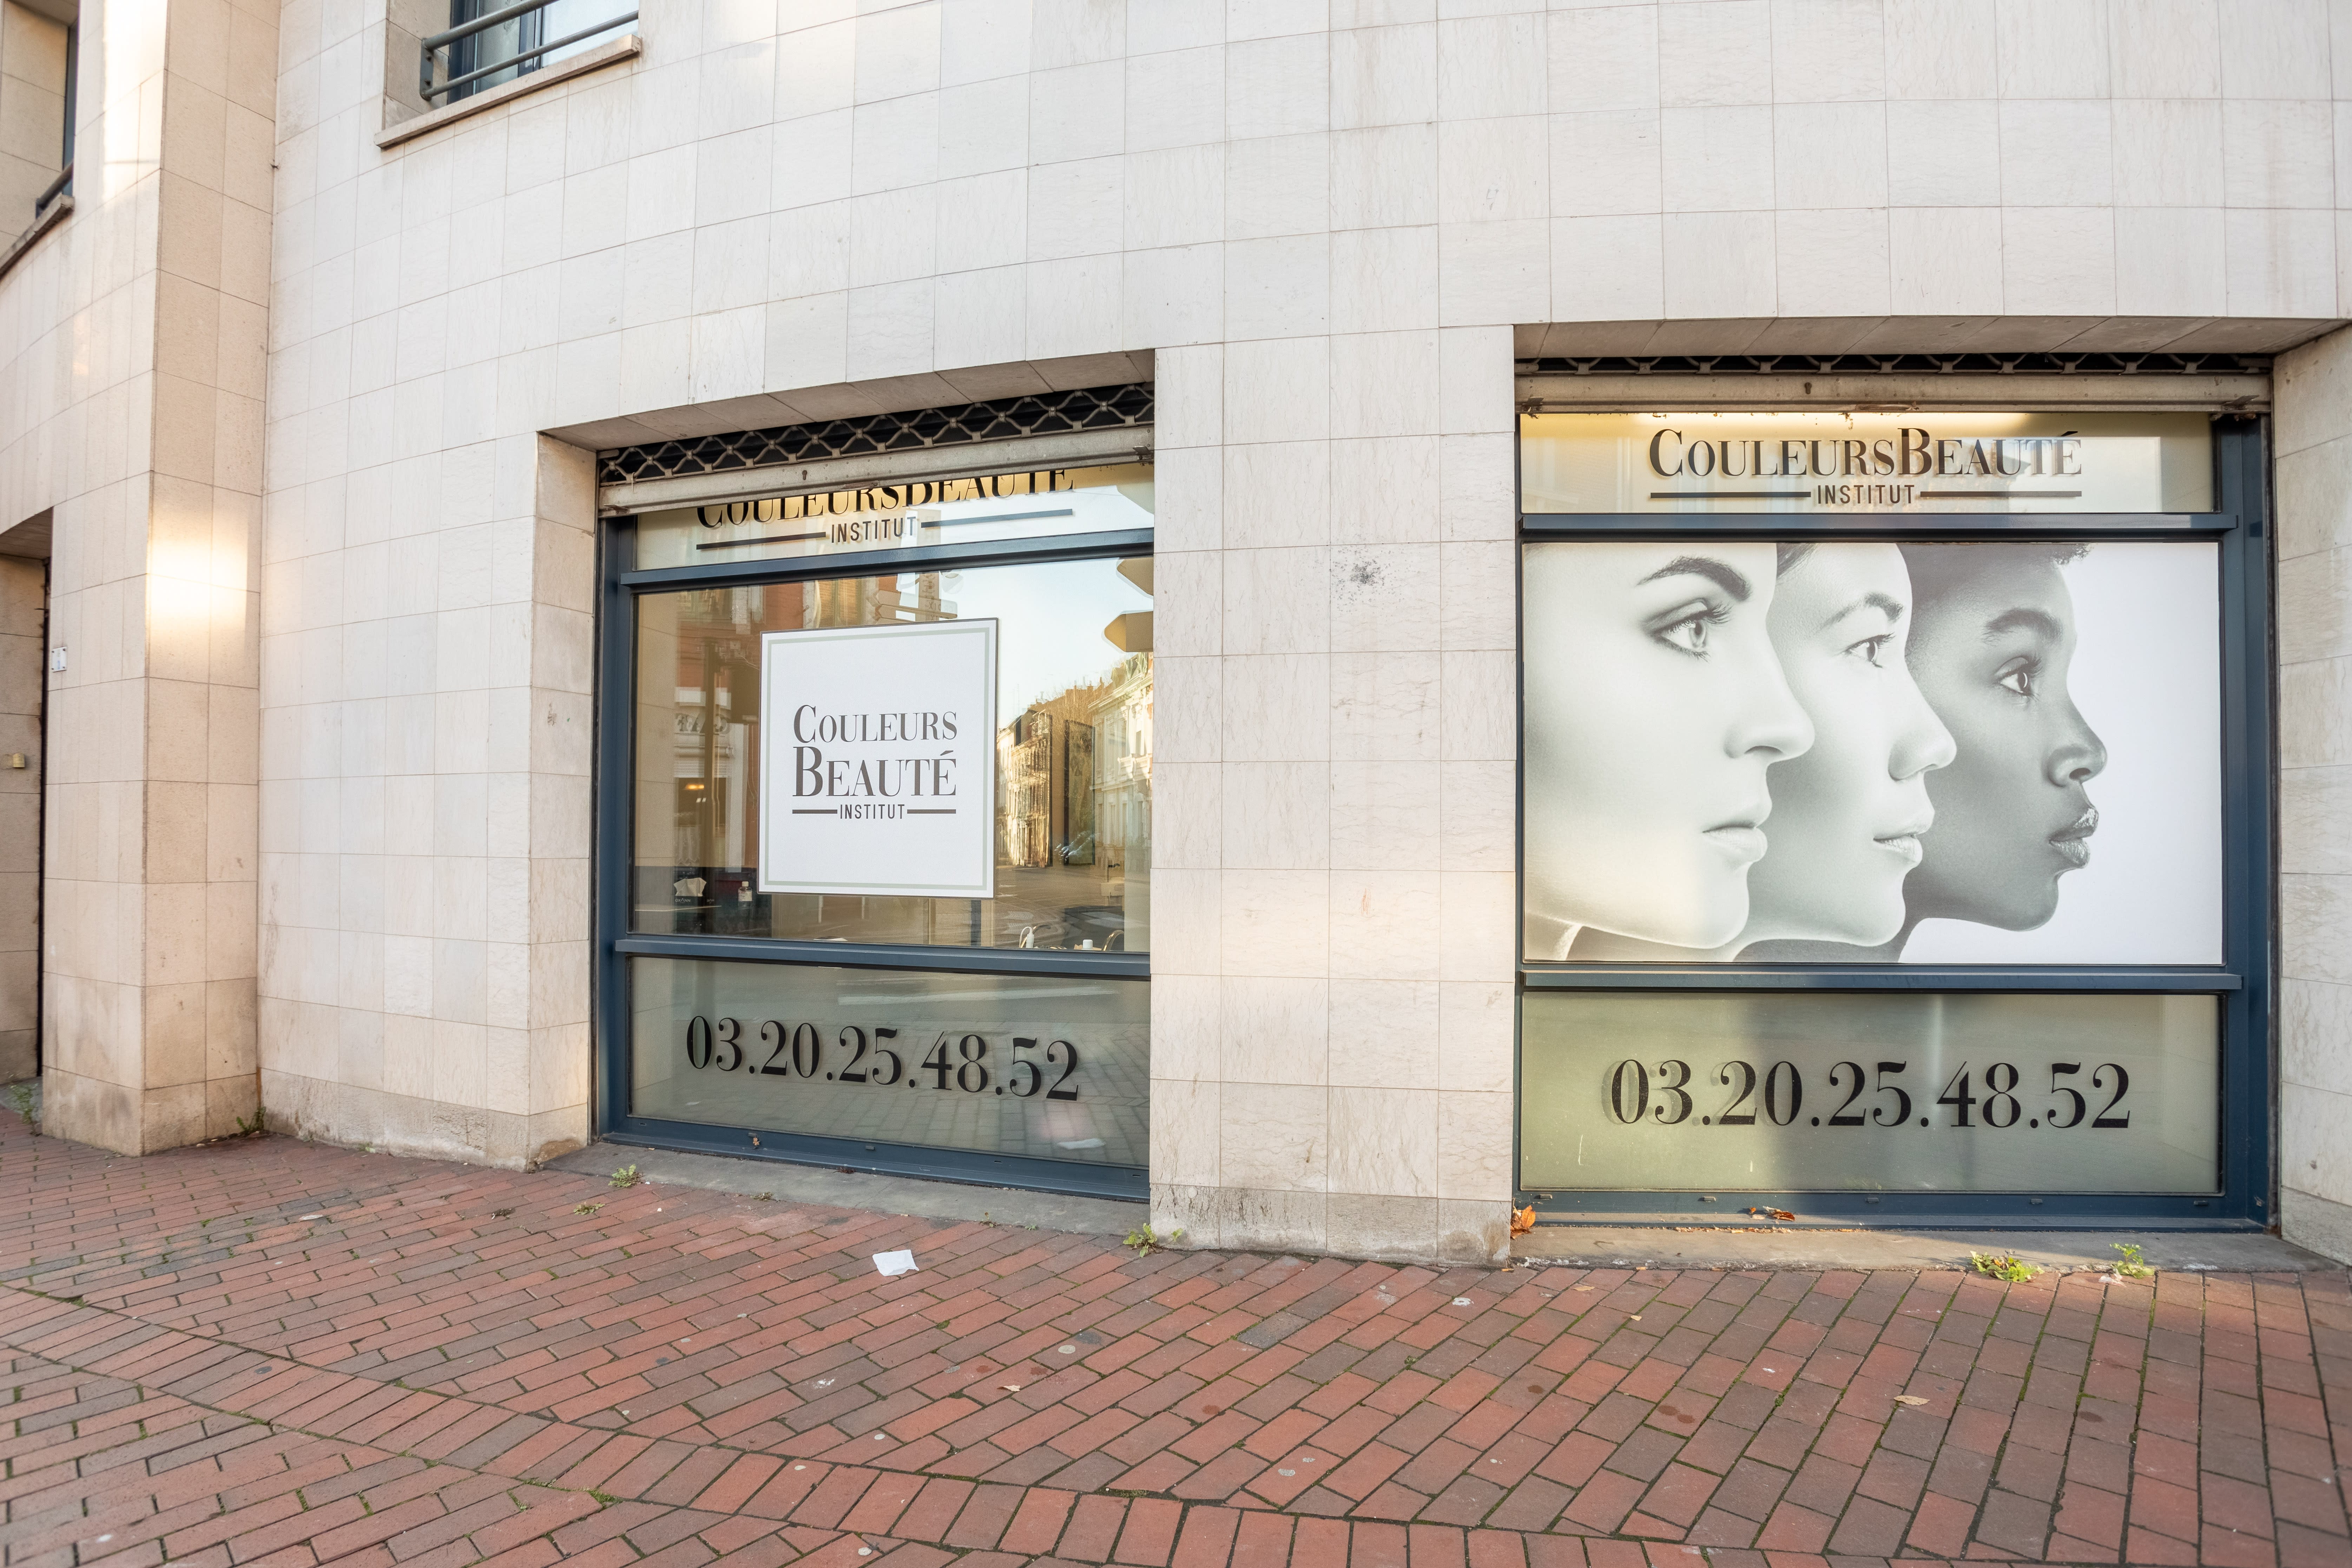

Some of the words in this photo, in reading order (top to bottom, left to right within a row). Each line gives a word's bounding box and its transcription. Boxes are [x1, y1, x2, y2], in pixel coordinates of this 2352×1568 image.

[1817, 485, 1915, 505] INSTITUT
[831, 516, 916, 543] INSTITUT
[793, 704, 957, 743] COULEURS
[792, 746, 956, 797] BEAUTÉ
[839, 804, 905, 819] INSTITUT
[686, 1015, 1079, 1101] 03.20.25.48.52
[1610, 1059, 2131, 1129] 03.20.25.48.52
